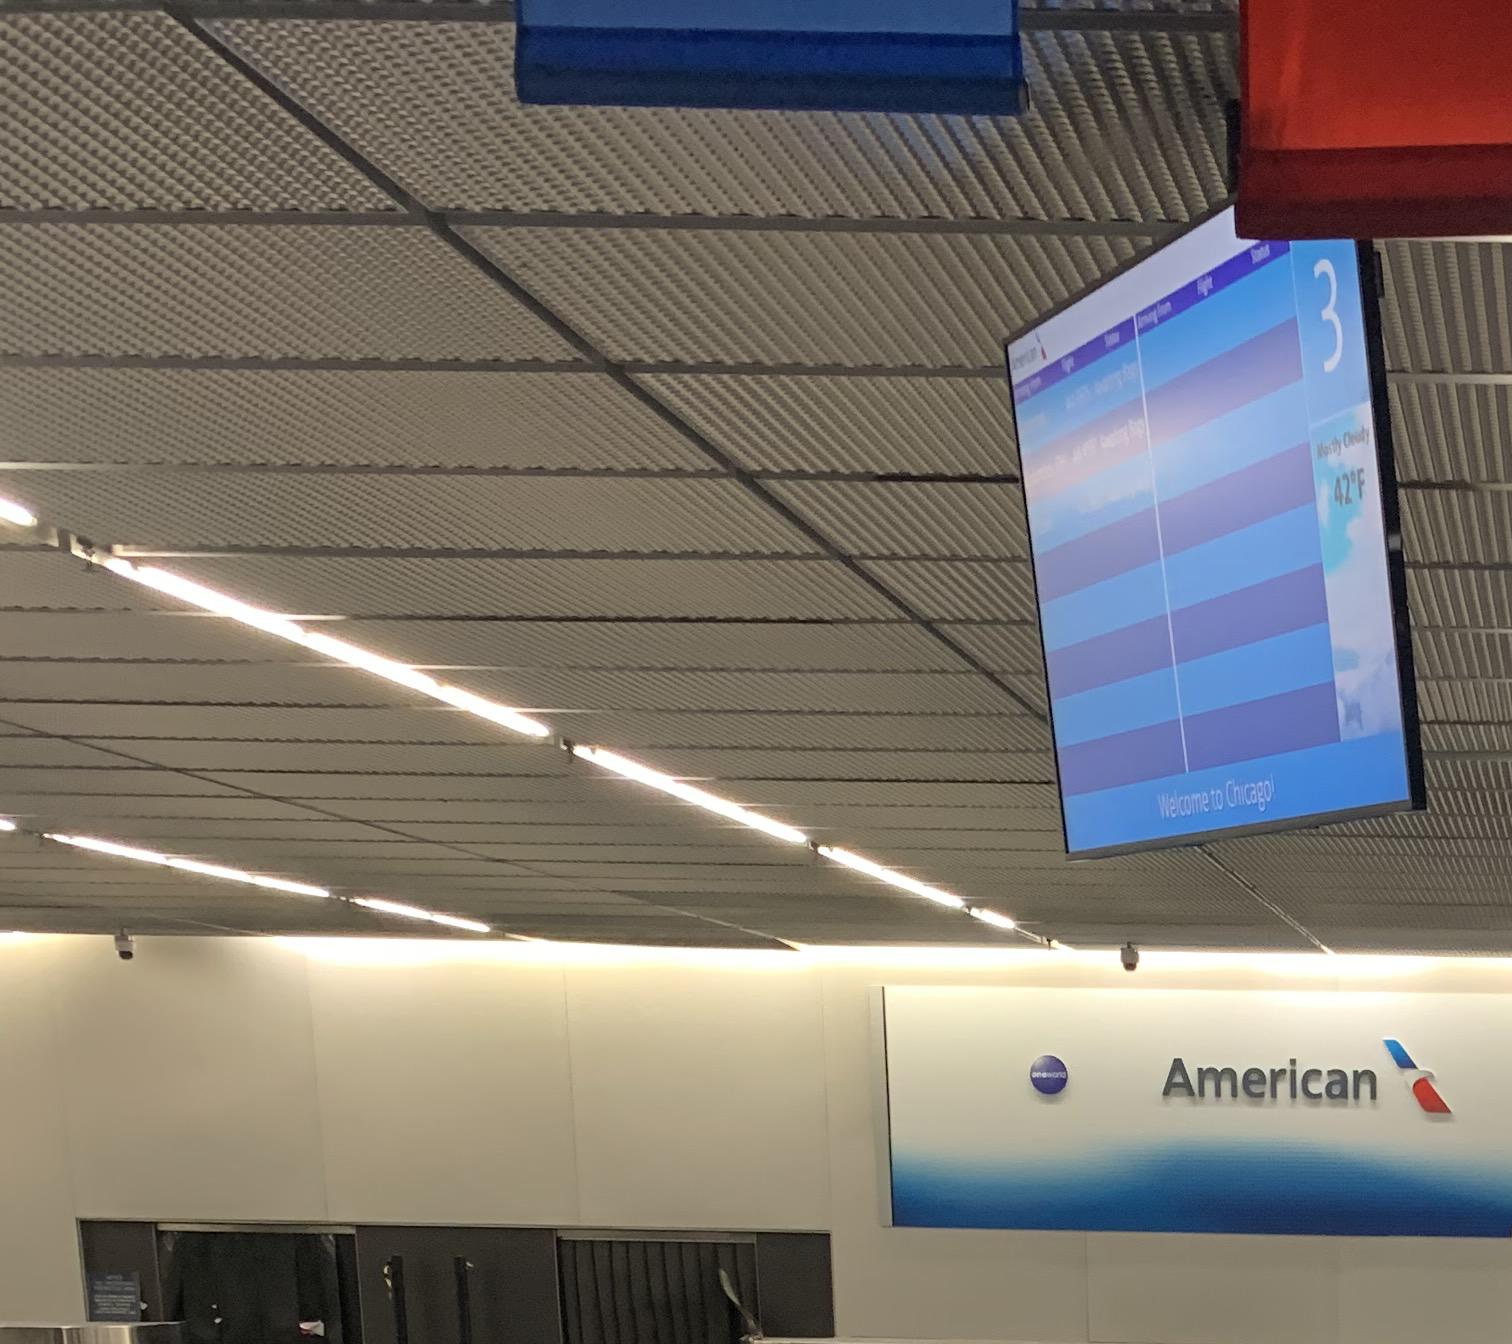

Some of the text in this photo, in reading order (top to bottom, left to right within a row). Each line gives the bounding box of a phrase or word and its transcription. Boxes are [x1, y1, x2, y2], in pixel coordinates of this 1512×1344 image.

[1313, 258, 1344, 374] 3
[1342, 425, 1371, 448] Cloudy
[1333, 467, 1366, 508] 42°F
[1157, 774, 1276, 819] Welcome to Chicago!
[1162, 1057, 1378, 1101] American
